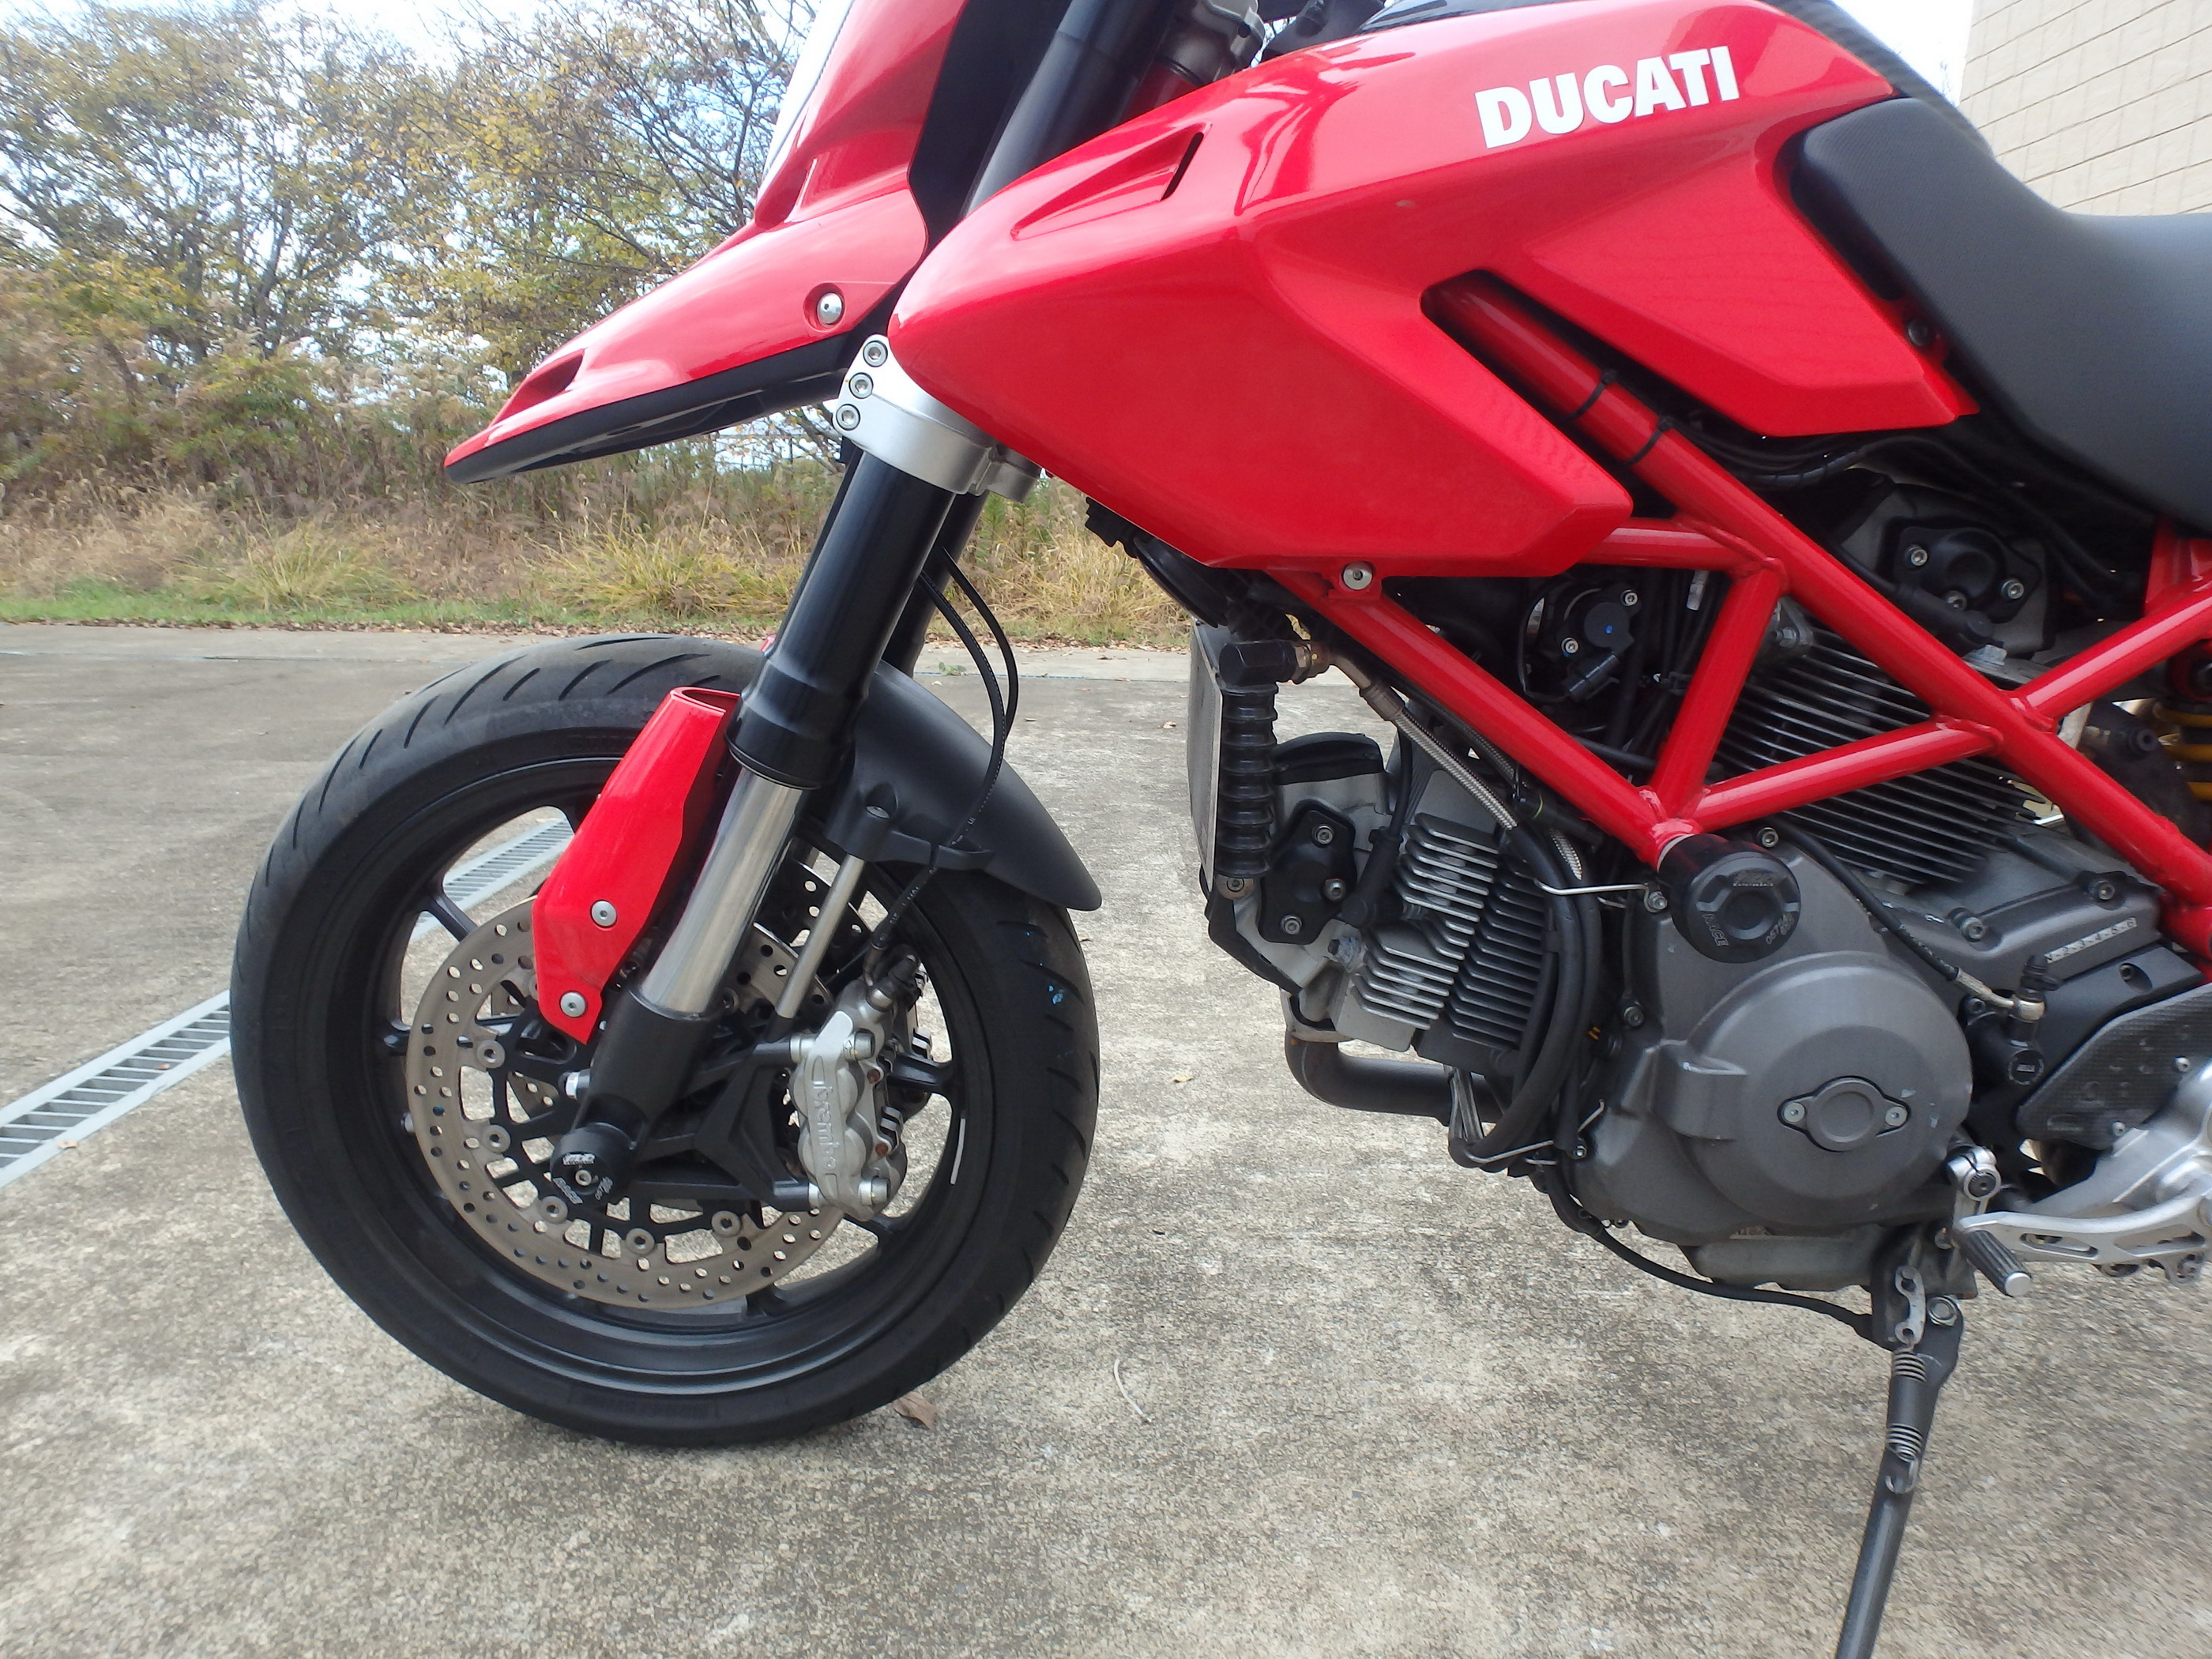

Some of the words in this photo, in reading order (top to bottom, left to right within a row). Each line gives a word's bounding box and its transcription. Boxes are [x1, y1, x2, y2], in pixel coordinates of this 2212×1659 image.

[1474, 45, 1740, 149] DUCATI
[1702, 913, 1729, 946] RACE
[813, 1083, 839, 1175] brembo
